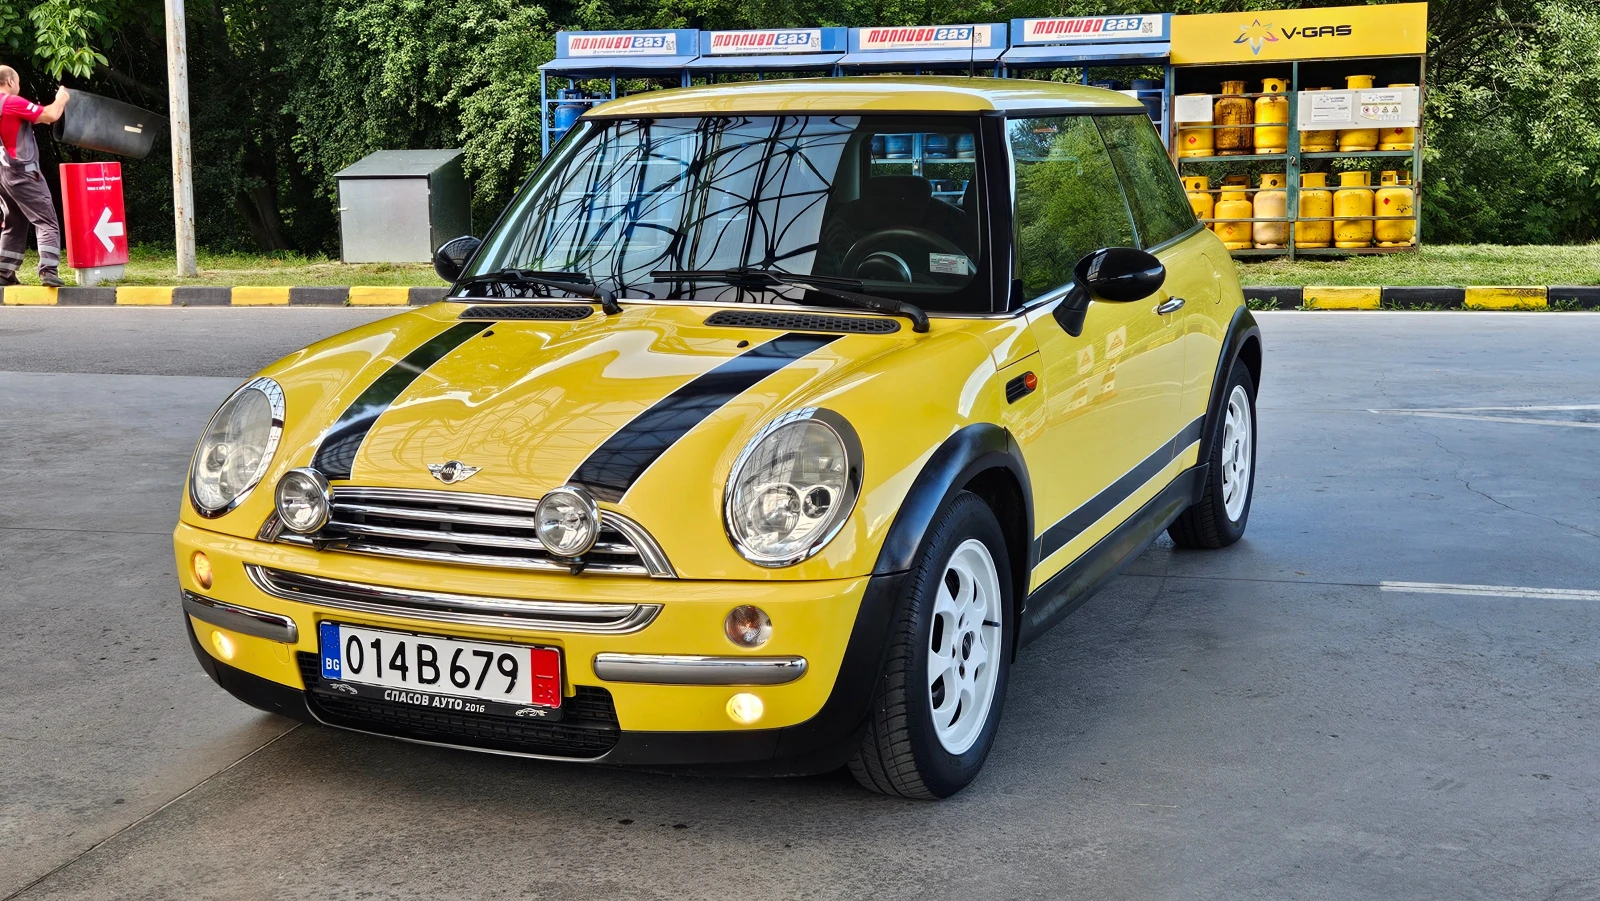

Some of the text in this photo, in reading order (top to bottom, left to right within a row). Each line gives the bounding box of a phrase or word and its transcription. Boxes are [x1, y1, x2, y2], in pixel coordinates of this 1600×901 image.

[1281, 25, 1352, 40] V-GAS
[325, 657, 340, 671] BG
[346, 635, 519, 694] 014B679
[384, 689, 485, 713] СПАСОВ АУТО 2016
